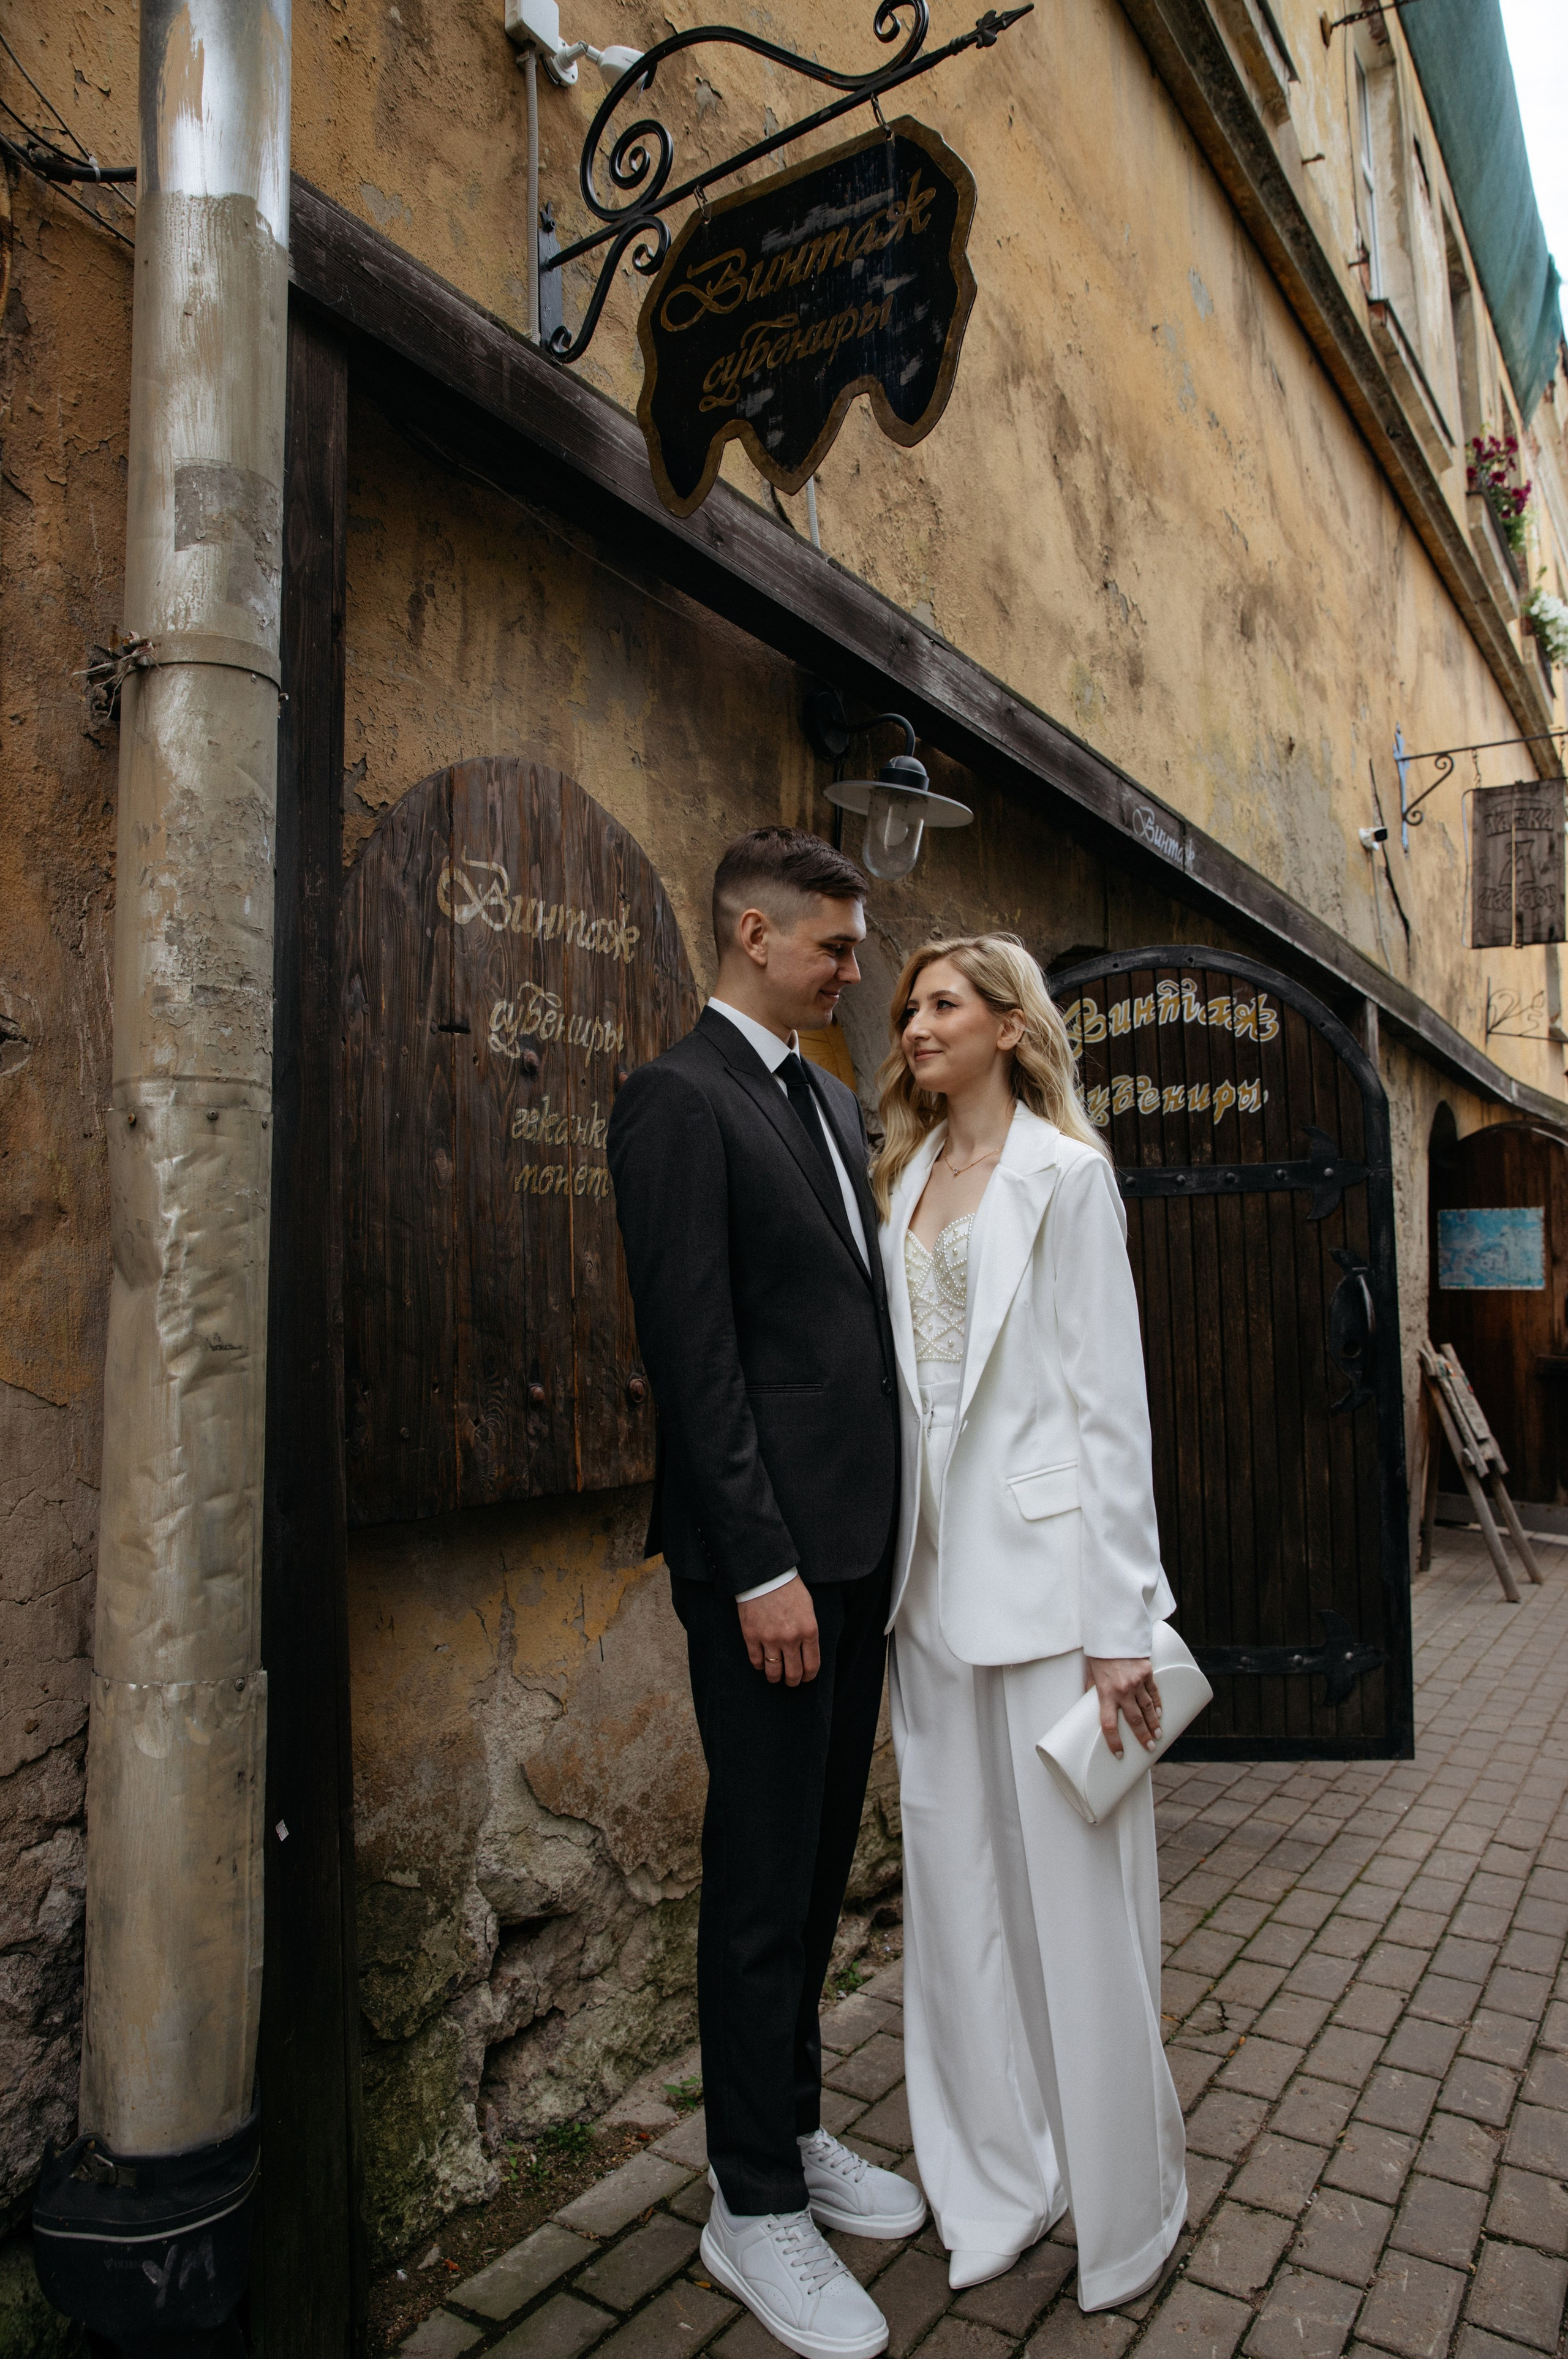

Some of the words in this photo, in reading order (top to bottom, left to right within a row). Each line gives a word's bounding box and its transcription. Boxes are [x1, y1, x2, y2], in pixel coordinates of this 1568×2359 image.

[660, 168, 936, 331] Винтаж
[698, 294, 894, 412] сувениры
[1133, 805, 1196, 872] Винтаж
[436, 846, 640, 964] Винтаж
[488, 981, 624, 1068] сувениры
[513, 1163, 609, 1198] монет
